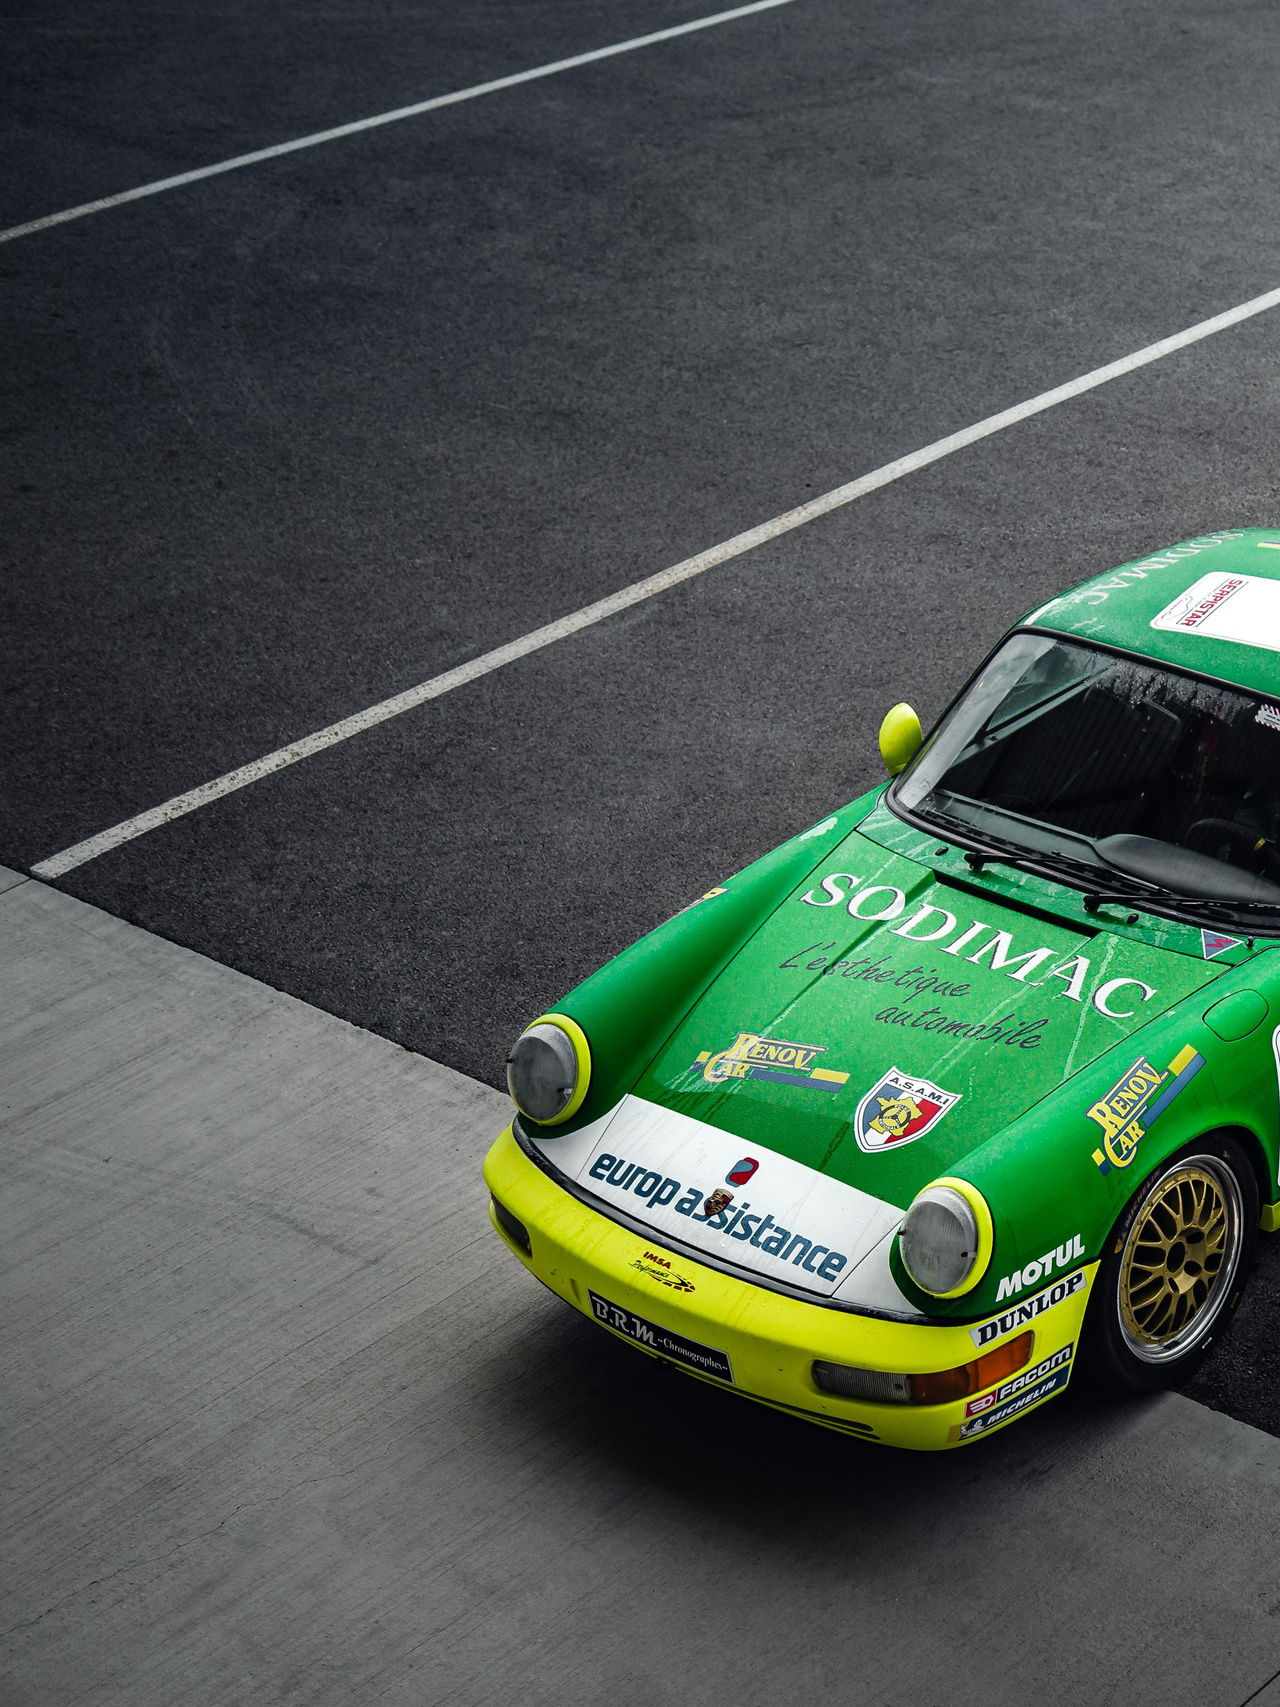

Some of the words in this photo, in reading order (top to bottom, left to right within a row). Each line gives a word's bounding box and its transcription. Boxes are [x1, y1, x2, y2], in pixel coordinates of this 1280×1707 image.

[1180, 579, 1243, 627] SERPISTAR
[799, 872, 1158, 1020] SODIMAC
[779, 941, 971, 1004] L'esthetique
[726, 1034, 817, 1069] RENOV
[874, 1005, 1048, 1050] automobile
[703, 1050, 750, 1083] CAR
[889, 1077, 950, 1105] A.S.A.M.I
[1087, 1063, 1162, 1139] RENOV
[1104, 1120, 1145, 1169] CAR
[589, 1153, 681, 1208] europ
[643, 1251, 671, 1269] IMSA
[995, 1233, 1085, 1302] MOTUL
[592, 1296, 657, 1346] B.R.M
[978, 1272, 1083, 1346] DUNLOP
[999, 1347, 1071, 1400] FACOM
[987, 1378, 1057, 1425] MICHELIN
